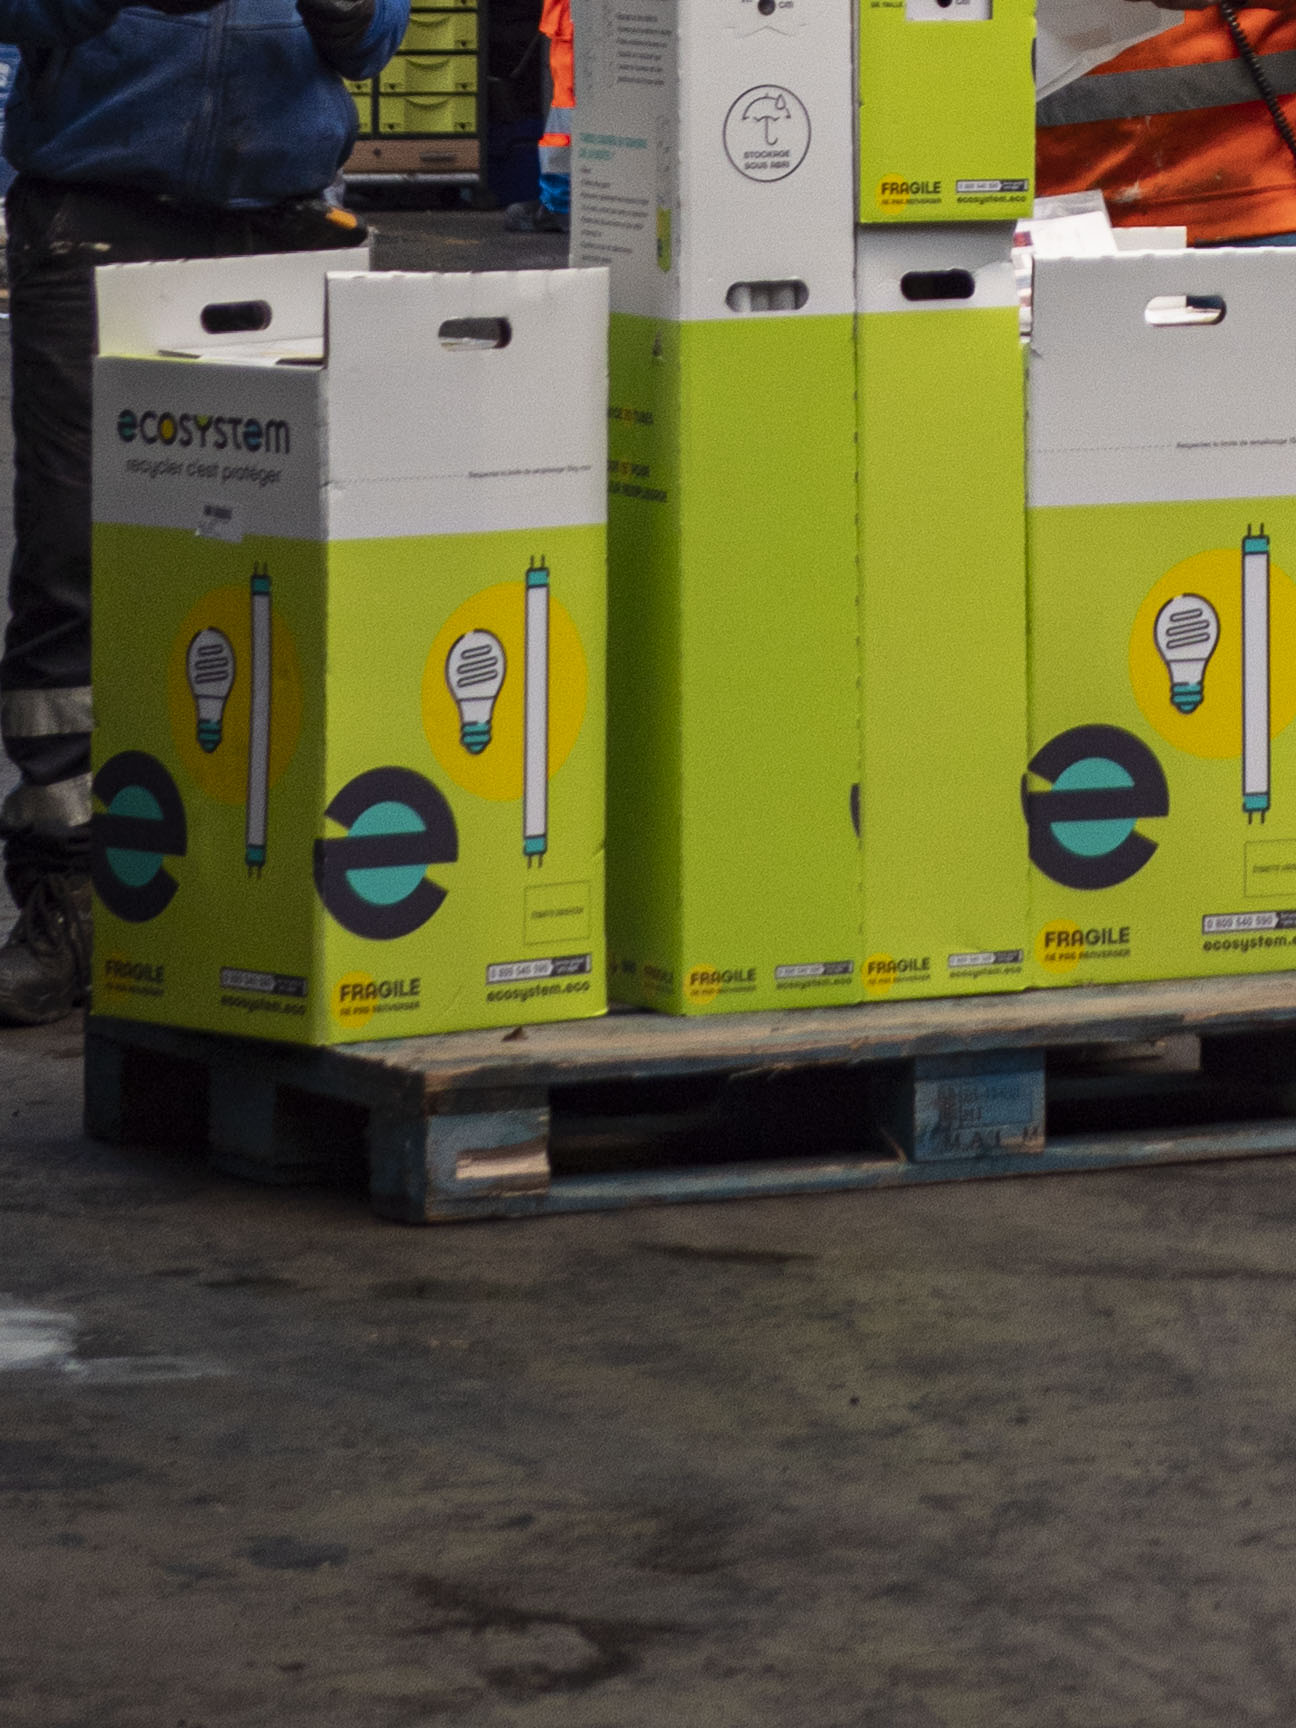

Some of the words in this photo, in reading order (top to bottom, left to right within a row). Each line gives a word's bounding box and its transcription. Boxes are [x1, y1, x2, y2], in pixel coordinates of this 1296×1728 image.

[881, 181, 942, 195] FRAGILE
[126, 458, 184, 479] recycler
[1044, 927, 1131, 948] FRAGILE
[868, 957, 931, 975] FRAGILE
[690, 968, 757, 986] FRAGILE
[339, 977, 421, 1002] FRAGILE
[486, 980, 590, 1003] ecosystem.eco
